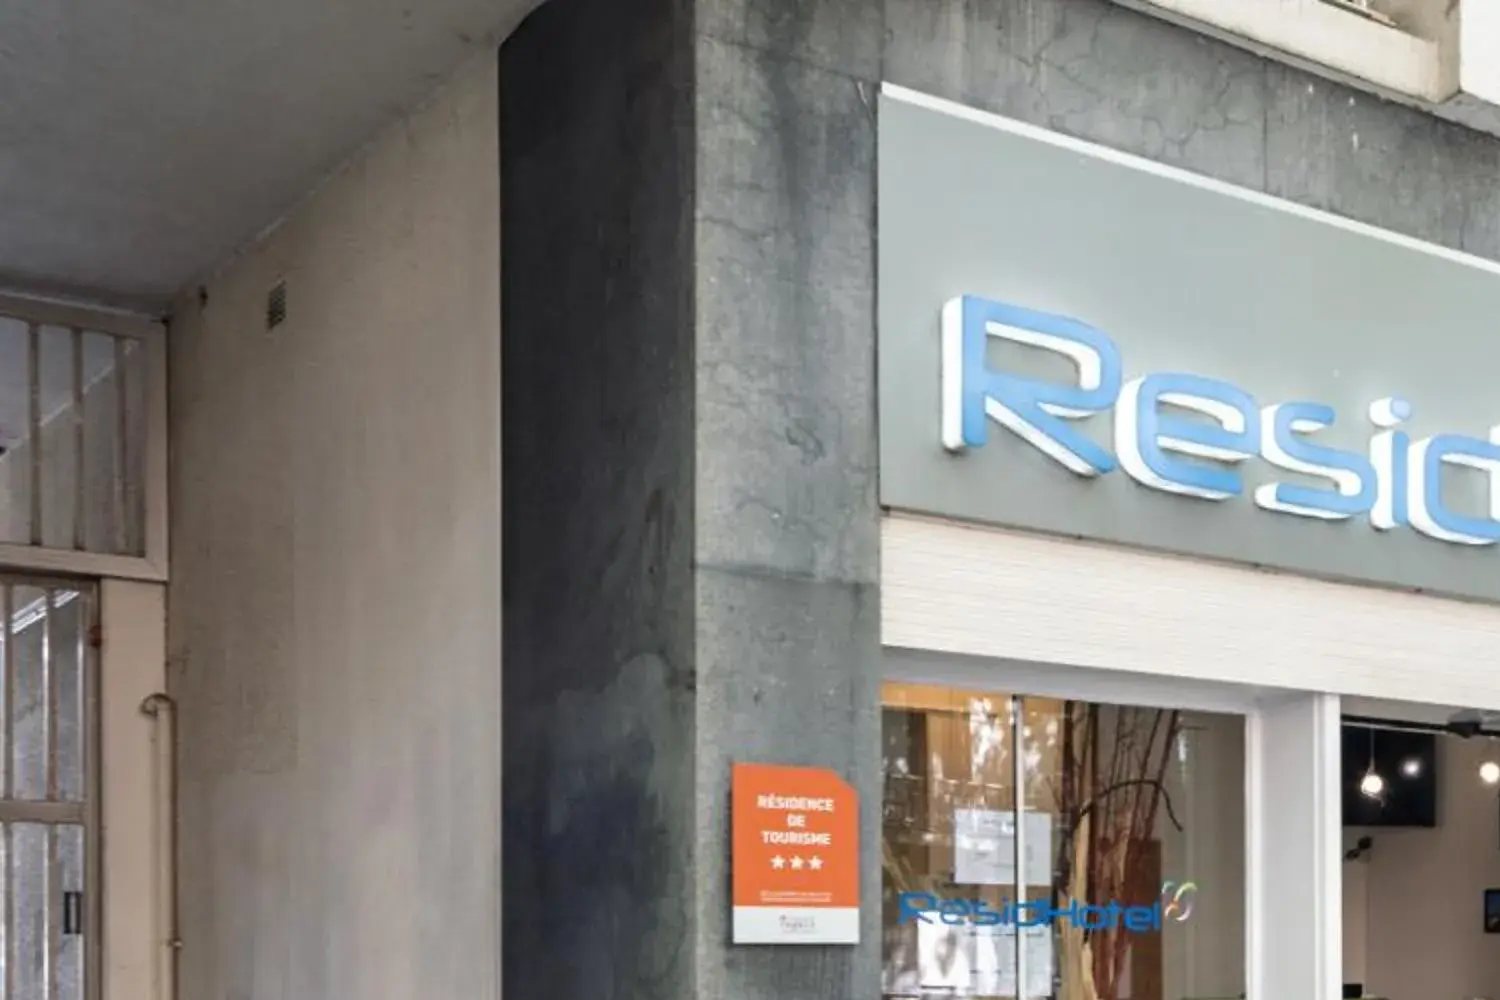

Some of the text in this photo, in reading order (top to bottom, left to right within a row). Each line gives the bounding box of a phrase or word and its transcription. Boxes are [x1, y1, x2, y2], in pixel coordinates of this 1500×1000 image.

[757, 794, 834, 811] RÉSIDENCE
[787, 813, 806, 827] DE
[761, 831, 832, 845] TOURISME
[896, 891, 1161, 933] ResidHotel
